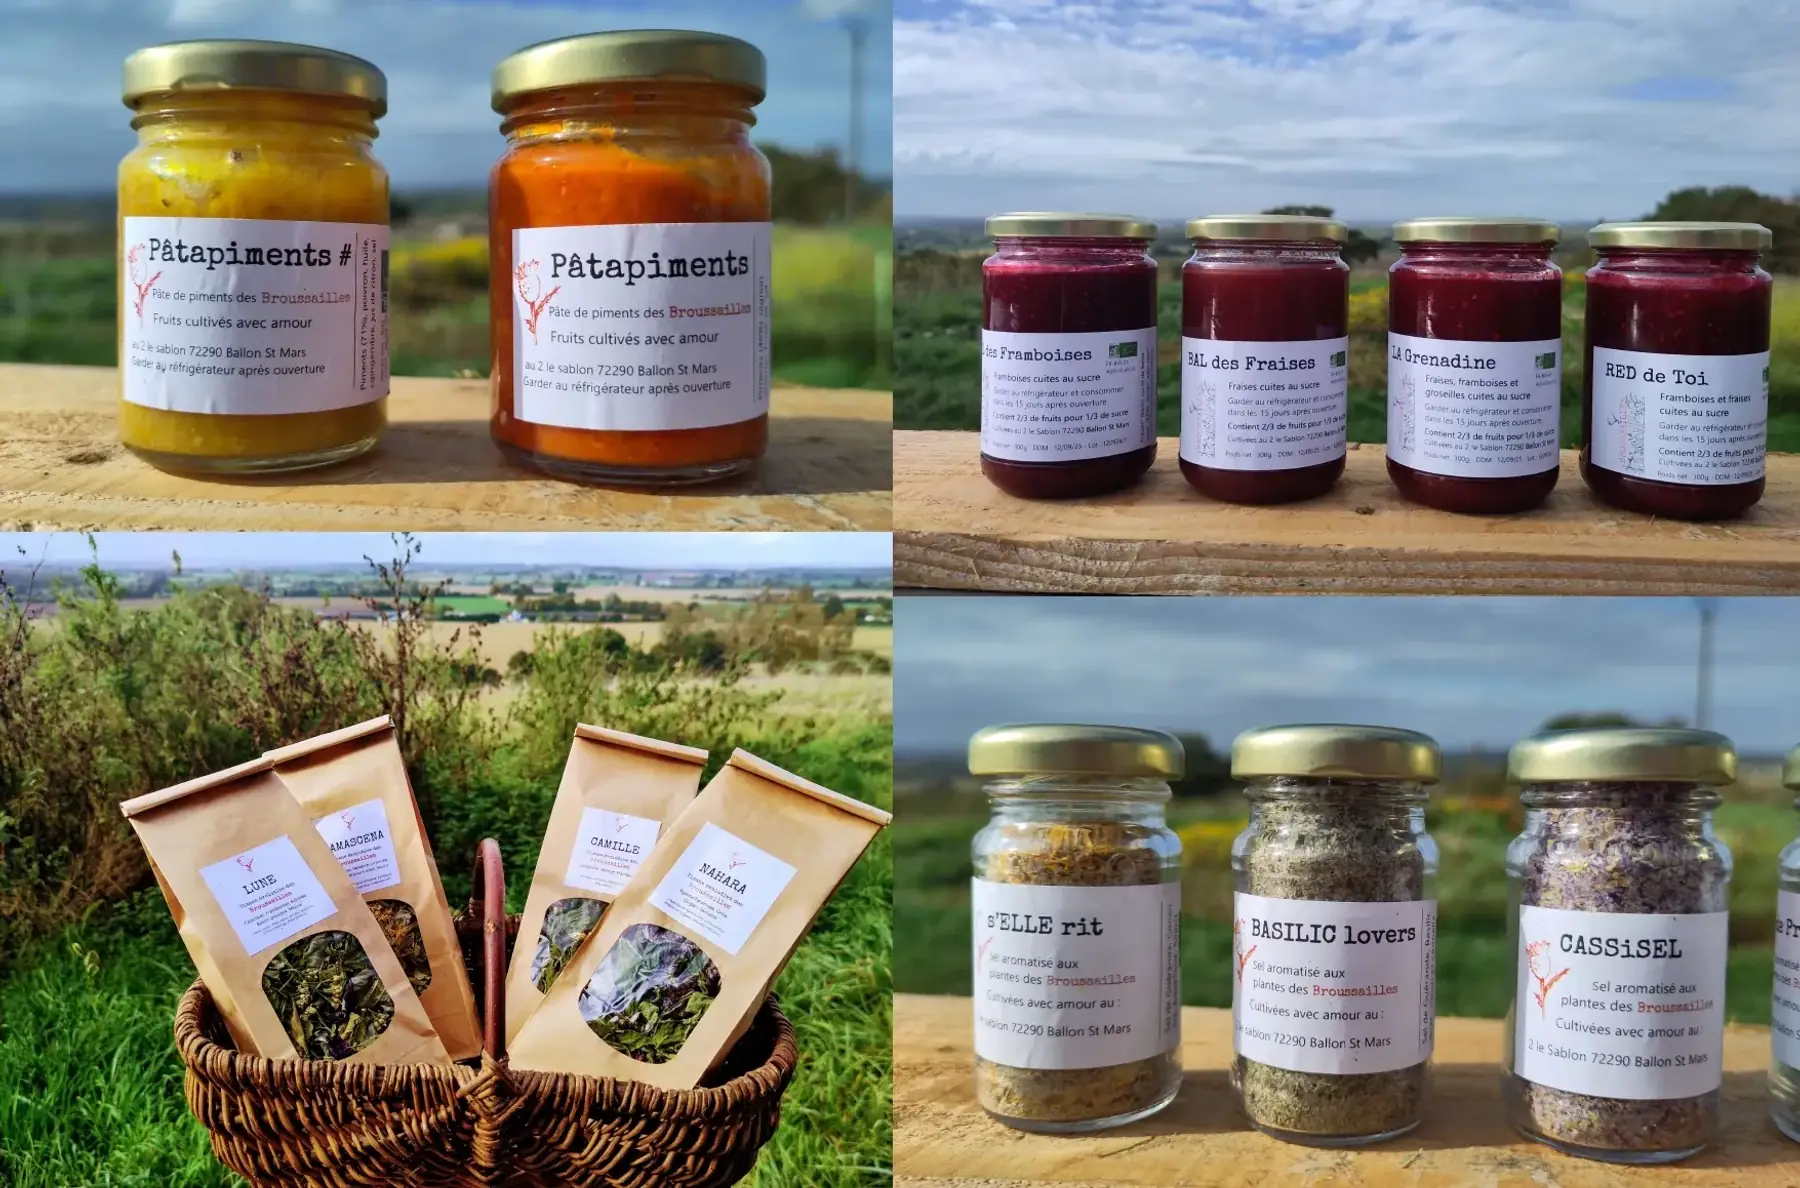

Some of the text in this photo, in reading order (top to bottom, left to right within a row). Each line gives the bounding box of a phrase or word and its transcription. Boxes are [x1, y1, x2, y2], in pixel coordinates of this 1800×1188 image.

[149, 238, 352, 271] Pâtapiments #
[551, 250, 749, 286] Pâtapiments
[152, 289, 351, 304] Pâte de piments des Broussailles
[371, 292, 375, 300] de
[549, 303, 751, 319] Pâte de piments des Broussailles
[153, 313, 313, 329] Fruits cultivés avec amour
[551, 331, 718, 345] Fruits cultivés avec amour
[132, 341, 307, 358] au 2 le sablon 72290 Ballon St Mars
[1000, 347, 1092, 361] Framboises
[1392, 345, 1496, 370] LA Grenadine
[132, 356, 326, 378] Garder au réfrigérateur après ouverture
[525, 361, 717, 376] au 2 le sablon 72290 Ballon St Mars
[1188, 352, 1315, 371] BAL des Fraises
[994, 372, 1101, 383] Framboises cuites au sucre
[1426, 375, 1519, 387] Fraises, framboises et
[1605, 362, 1709, 386] RED de Toi
[523, 377, 731, 396] Garder au réfrigérateur après ouverture
[1229, 381, 1320, 391] Fraises cuites au sucre
[1425, 389, 1465, 399] groseilles
[1468, 392, 1494, 400] cuites
[1510, 392, 1531, 400] sucre
[1660, 393, 1715, 403] Framboises
[1717, 395, 1726, 403] et
[1729, 393, 1751, 403] fraises
[1660, 407, 1688, 416] cuites
[1706, 409, 1729, 417] sucre
[1228, 422, 1259, 430] Contient
[1277, 422, 1286, 430] de
[1288, 421, 1306, 429] fruits
[590, 836, 640, 855] CAMILLE
[242, 874, 277, 895] LUNE
[698, 863, 747, 895] NAHARA
[987, 912, 1103, 936] s'ELLE rit
[1252, 918, 1415, 944] BASILIC lovers
[1560, 934, 1683, 959] CASSiSEL
[1002, 955, 1053, 969] aromatisé
[1057, 960, 1078, 969] aux
[1253, 961, 1345, 978] Sel aromatisé aux
[989, 970, 1135, 987] plantes des Broussailles
[1253, 979, 1398, 997] plantes des Broussailles
[1593, 981, 1696, 994] Sel aromatisé aux
[987, 990, 1024, 1007] Cultivées
[1027, 998, 1052, 1009] avec
[1056, 999, 1096, 1009] amour
[1561, 996, 1714, 1013] plantes des Broussailles
[1250, 999, 1290, 1017] Cultivées
[1294, 1009, 1319, 1019] avec
[1323, 1011, 1360, 1020] amour
[1424, 1011, 1428, 1023] de
[1012, 1023, 1044, 1035] 72290
[1047, 1024, 1084, 1037] Ballon
[1088, 1025, 1100, 1036] St
[1103, 1024, 1132, 1034] Mars
[1555, 1018, 1610, 1036] Cultivées
[1615, 1026, 1644, 1037] avec
[1648, 1026, 1684, 1037] amour
[1245, 1026, 1391, 1049] sablon 72290 Ballon St Mars
[1529, 1039, 1708, 1067] 2 le Sablon 72290 Ballon St Mars
